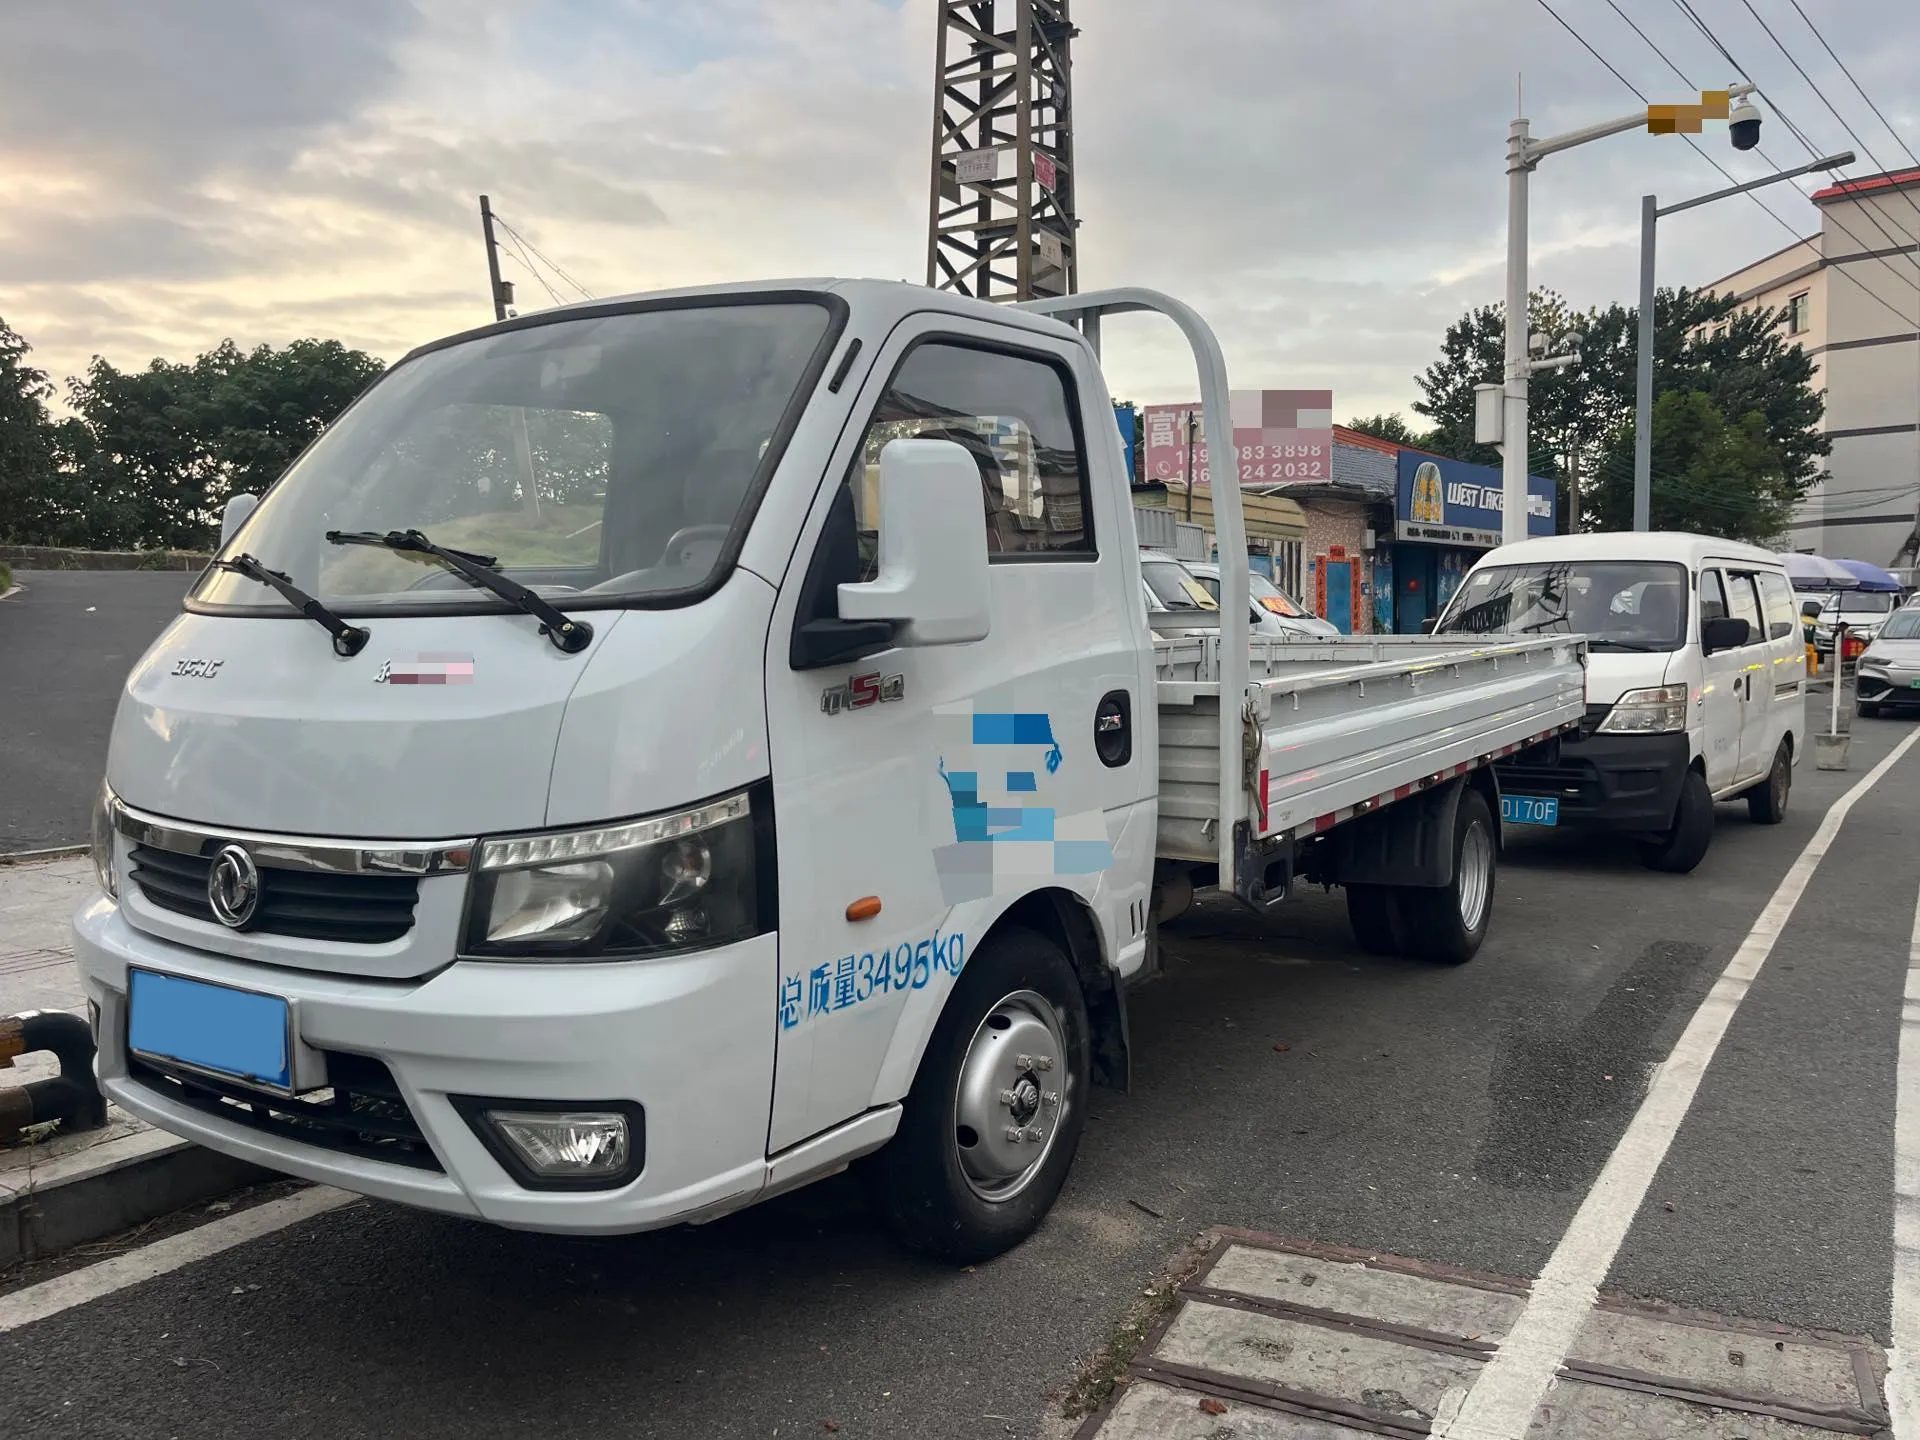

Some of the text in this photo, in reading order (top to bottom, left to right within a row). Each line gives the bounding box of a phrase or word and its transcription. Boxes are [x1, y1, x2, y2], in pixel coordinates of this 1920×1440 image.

[1272, 445, 1322, 459] 3898
[1271, 462, 1322, 478] 2032
[1447, 482, 1481, 507] WEST
